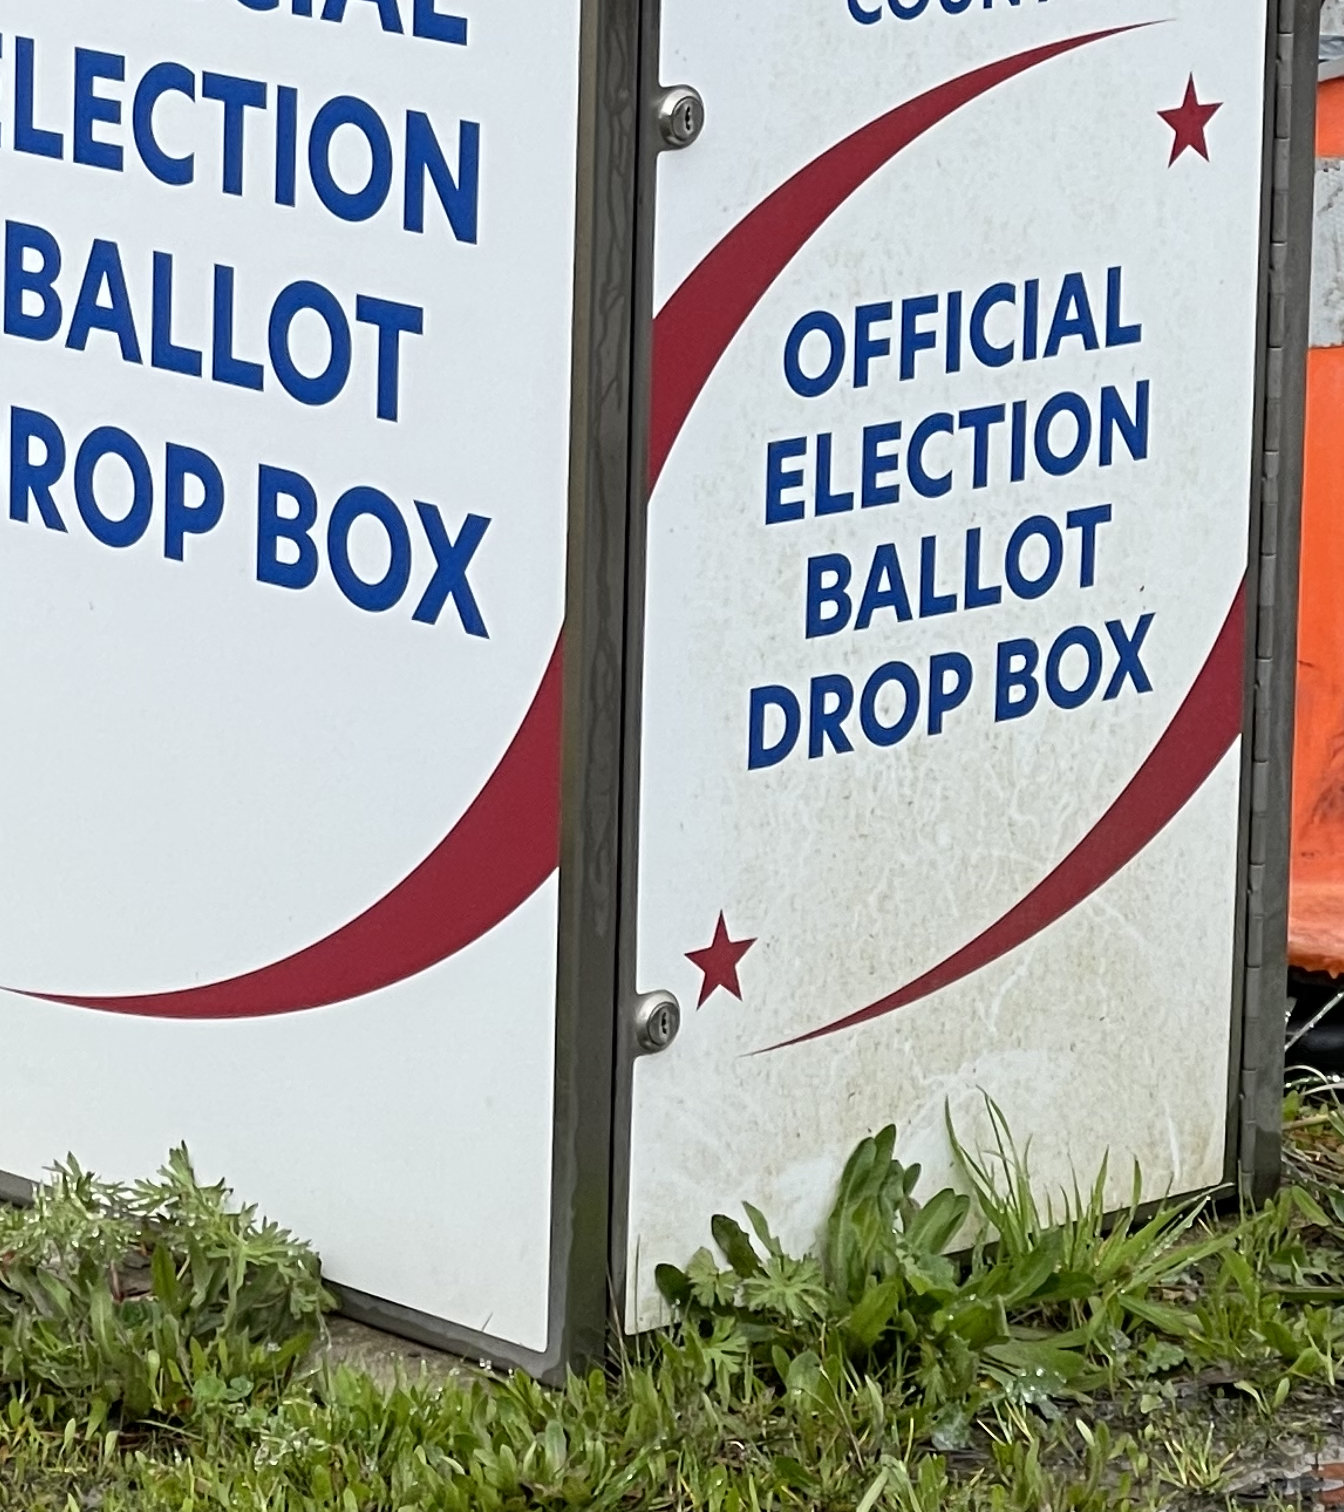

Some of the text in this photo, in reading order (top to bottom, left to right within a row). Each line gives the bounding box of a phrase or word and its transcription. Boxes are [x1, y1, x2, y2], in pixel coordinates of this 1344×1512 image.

[4, 221, 422, 420] BALLOT
[784, 267, 1140, 397] OFFICIAL
[766, 381, 1148, 524] ELECTION
[257, 464, 490, 637] BOX
[806, 505, 1111, 638] BALLOT
[749, 614, 1153, 769] DROP BOX
